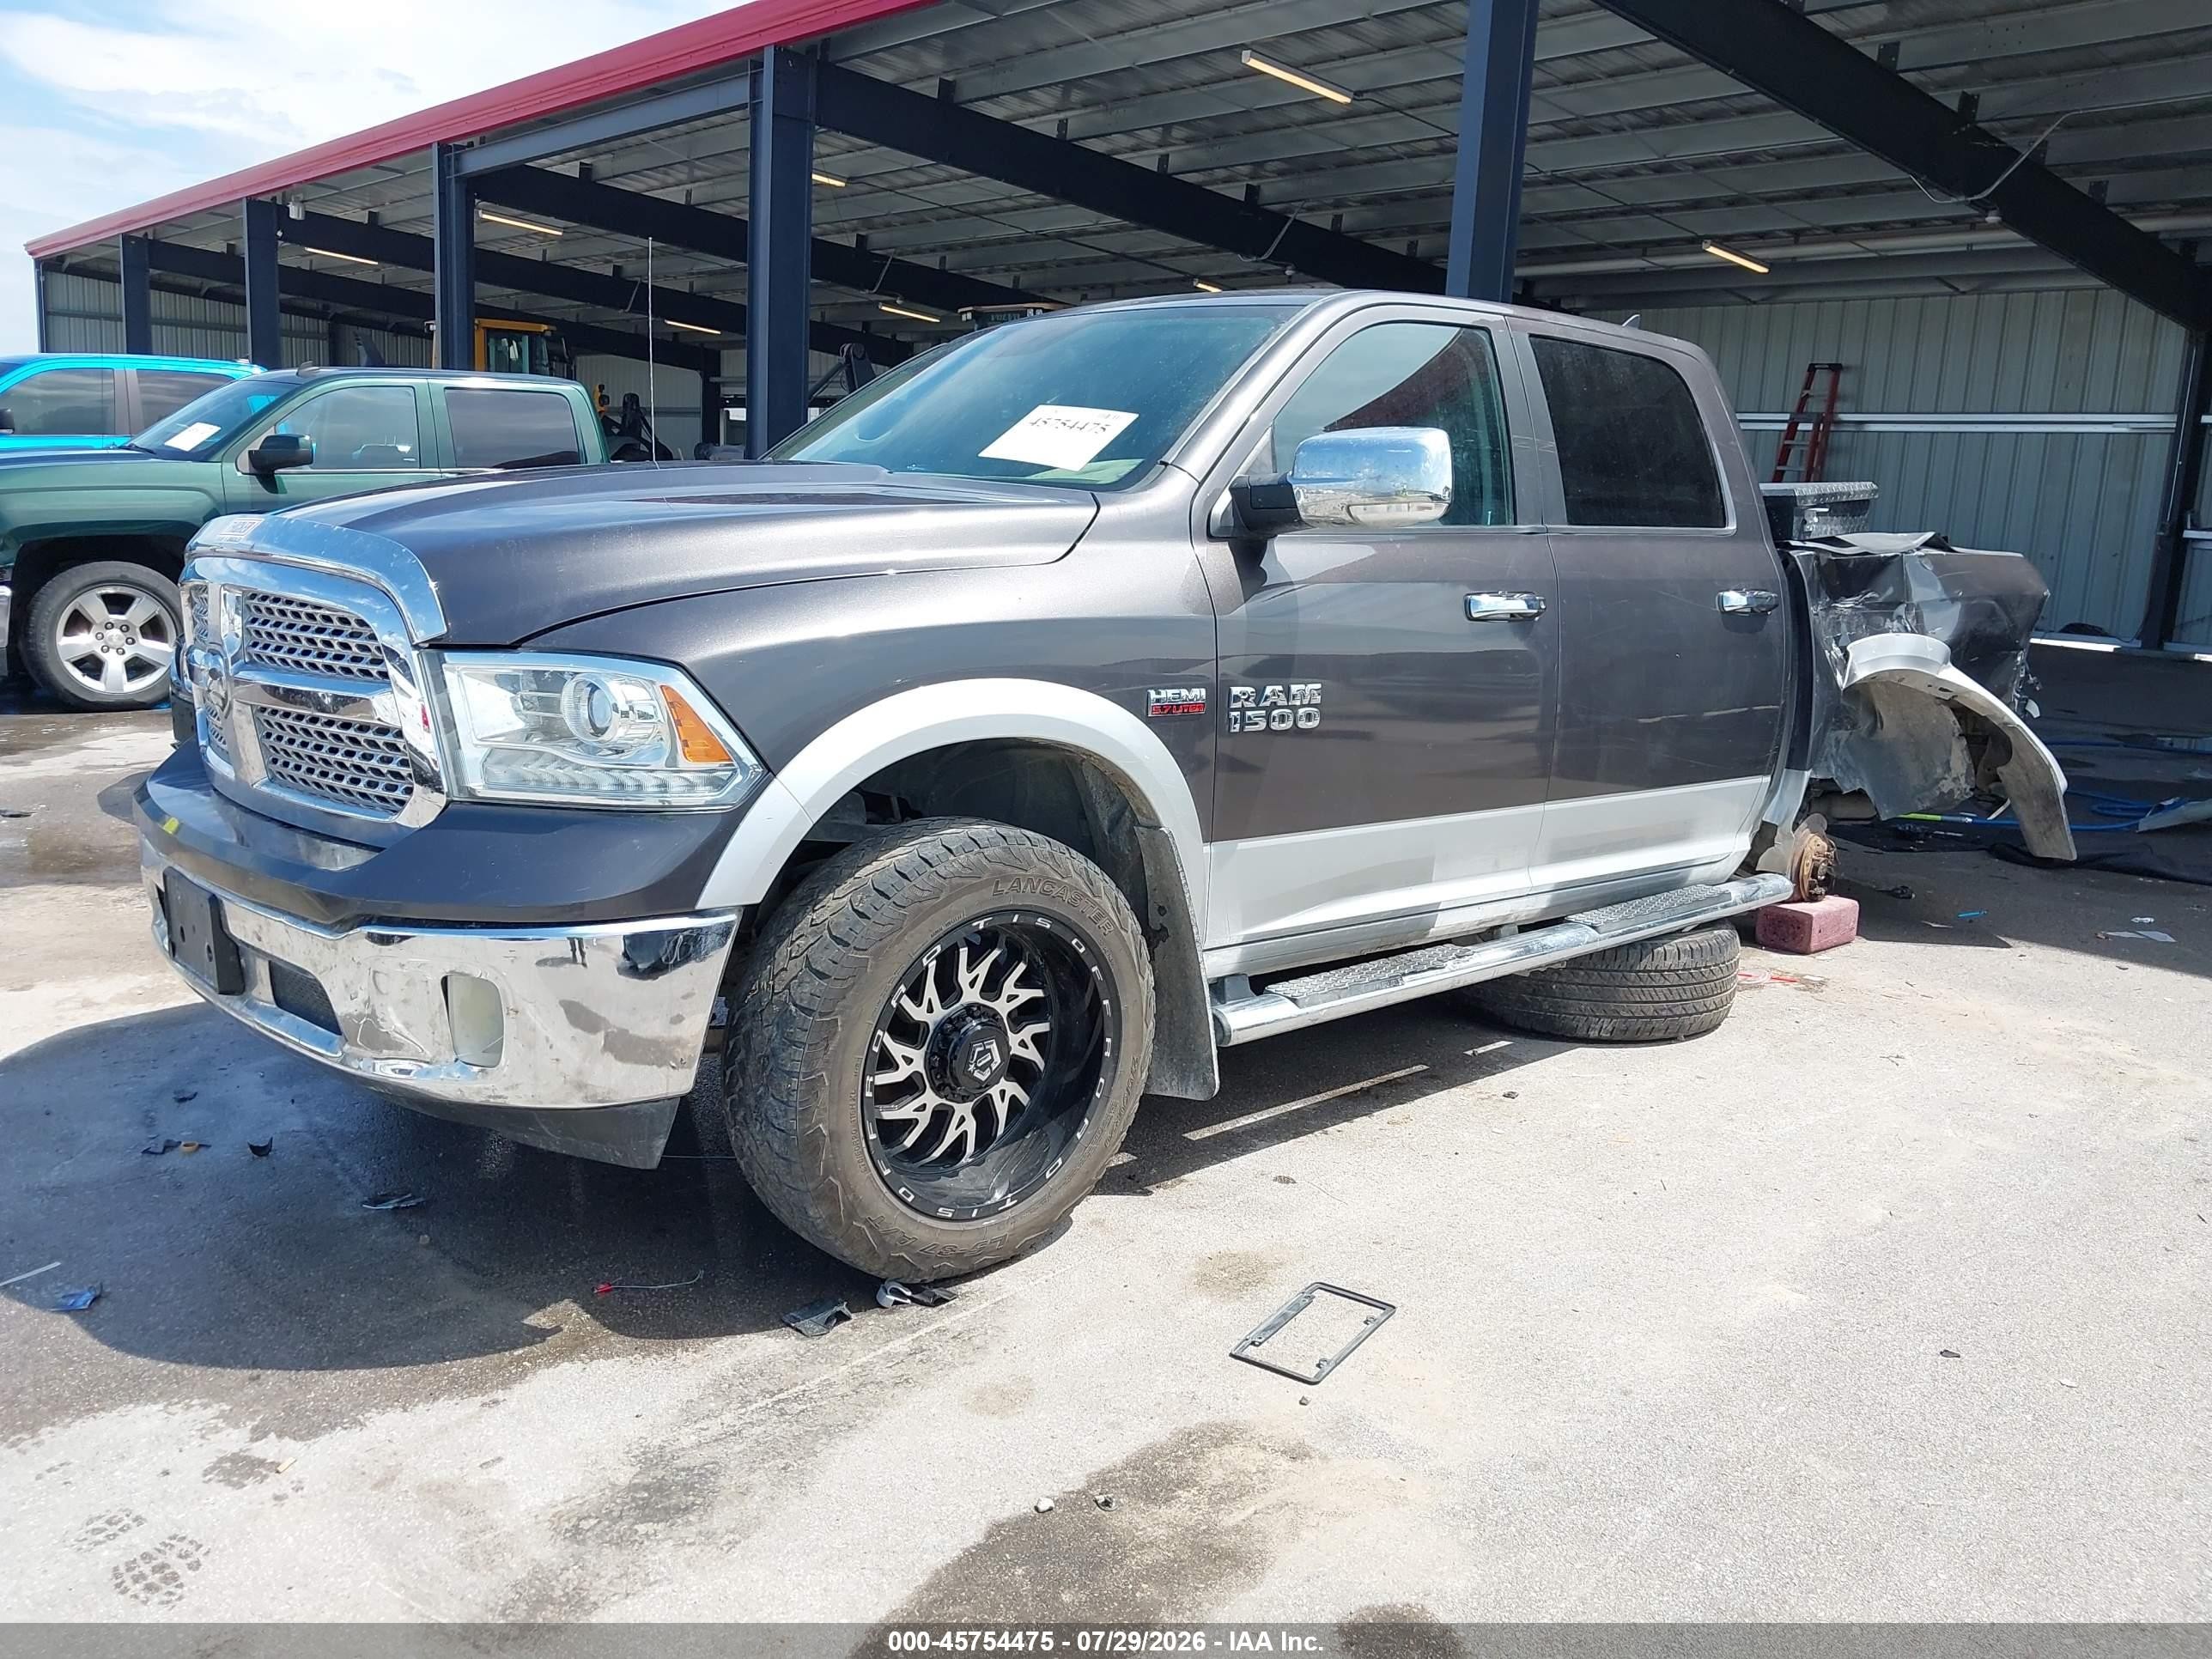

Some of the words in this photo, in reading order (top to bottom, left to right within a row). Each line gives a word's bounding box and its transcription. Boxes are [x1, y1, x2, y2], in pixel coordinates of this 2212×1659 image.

[1147, 688, 1206, 703] HEMI
[1229, 684, 1322, 708] RAM
[1152, 705, 1170, 714] 5.7
[1172, 703, 1205, 714] LITER
[1229, 708, 1321, 733] 1500
[992, 878, 1115, 937] LANCASTER
